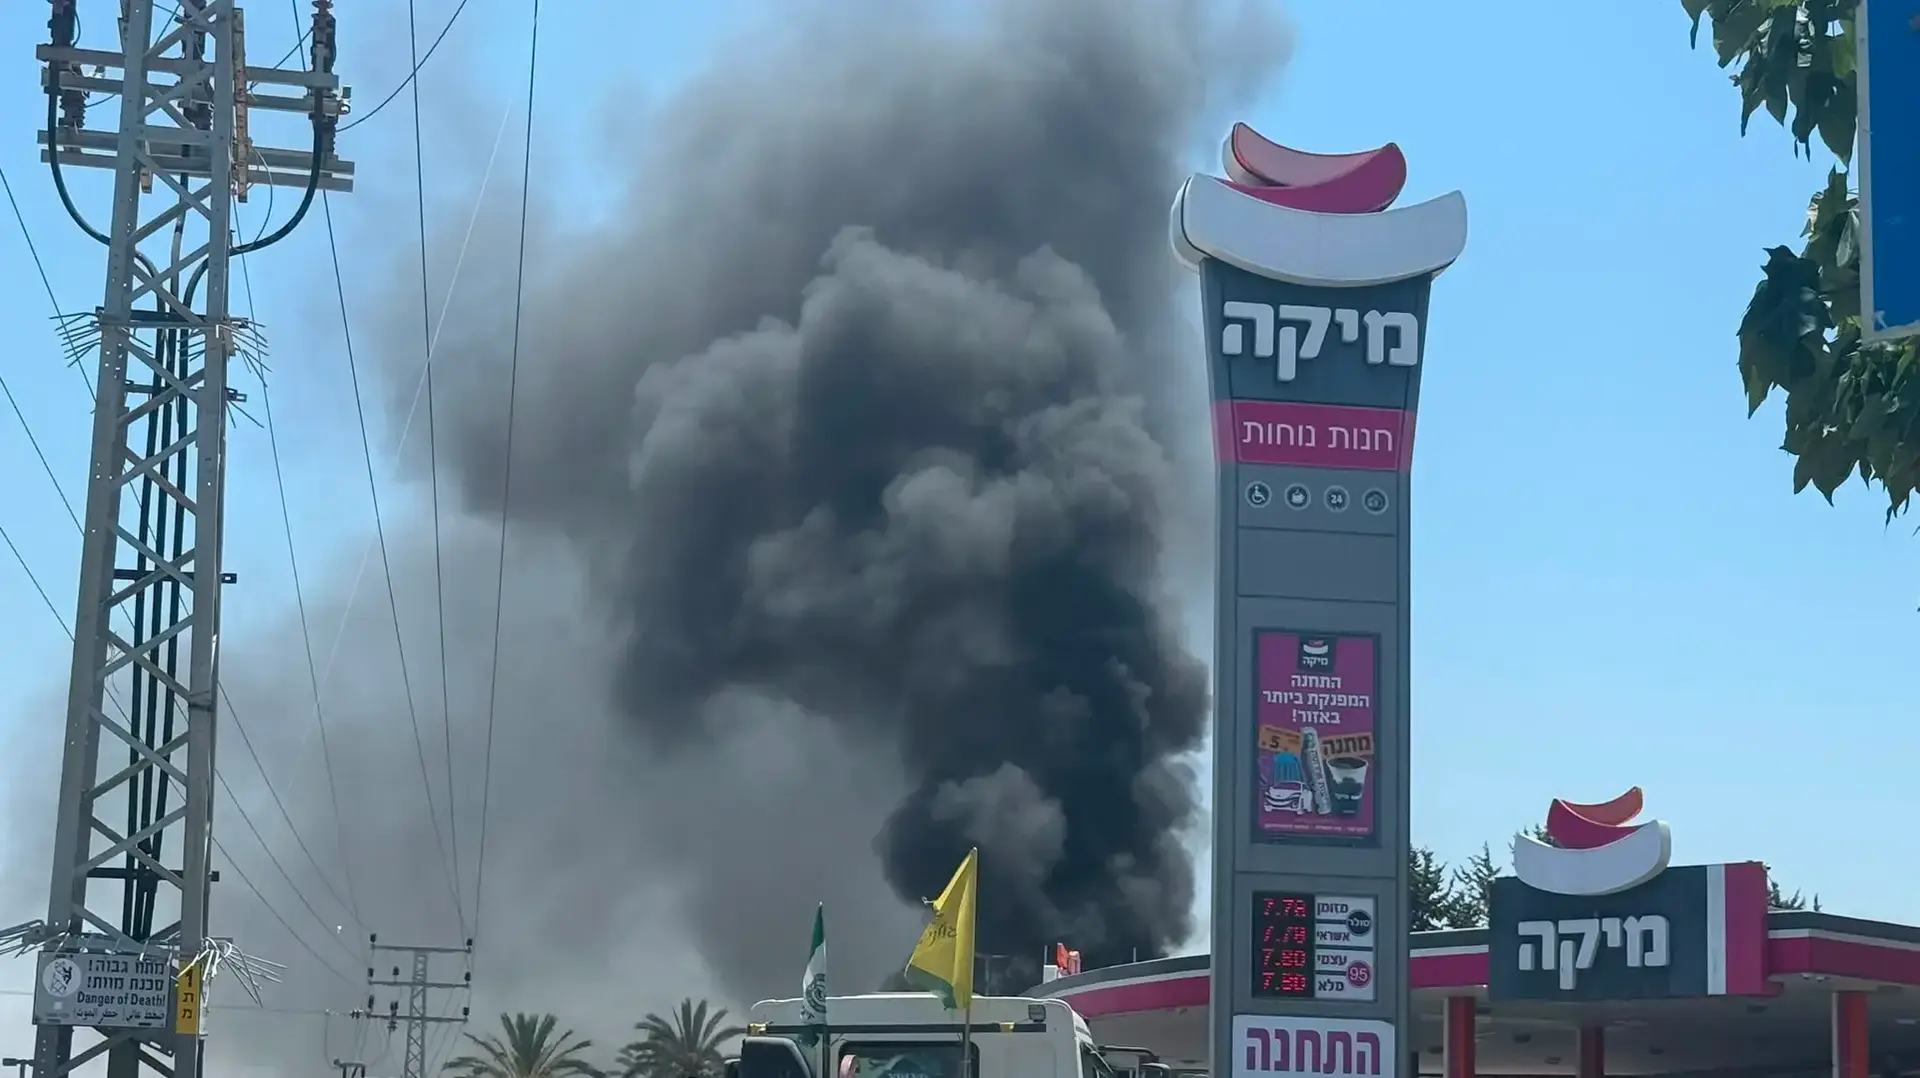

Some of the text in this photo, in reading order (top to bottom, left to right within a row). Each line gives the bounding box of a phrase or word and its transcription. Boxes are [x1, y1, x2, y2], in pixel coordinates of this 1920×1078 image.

[1222, 301, 1419, 381] מיקה
[1242, 421, 1393, 451] חנות נוחות
[1330, 494, 1343, 504] 24
[1302, 656, 1329, 668] מיקה
[1291, 675, 1341, 689] התחנה
[1262, 690, 1369, 710] המפנקת ביותר
[1292, 709, 1341, 724] באזור!
[1322, 736, 1371, 756] מתנה
[1317, 902, 1349, 916] מזומן
[1347, 917, 1371, 928] סולר
[1316, 931, 1350, 942] אשראי
[1518, 915, 1670, 990] מיקה
[88, 959, 128, 974] גבוה!
[1317, 955, 1347, 966] עצמי
[1349, 967, 1368, 982] 95
[87, 976, 125, 990] מוות!
[1318, 979, 1344, 992] מלא
[77, 991, 166, 1007] Danger of Death!
[1246, 1027, 1380, 1075] התחנה
